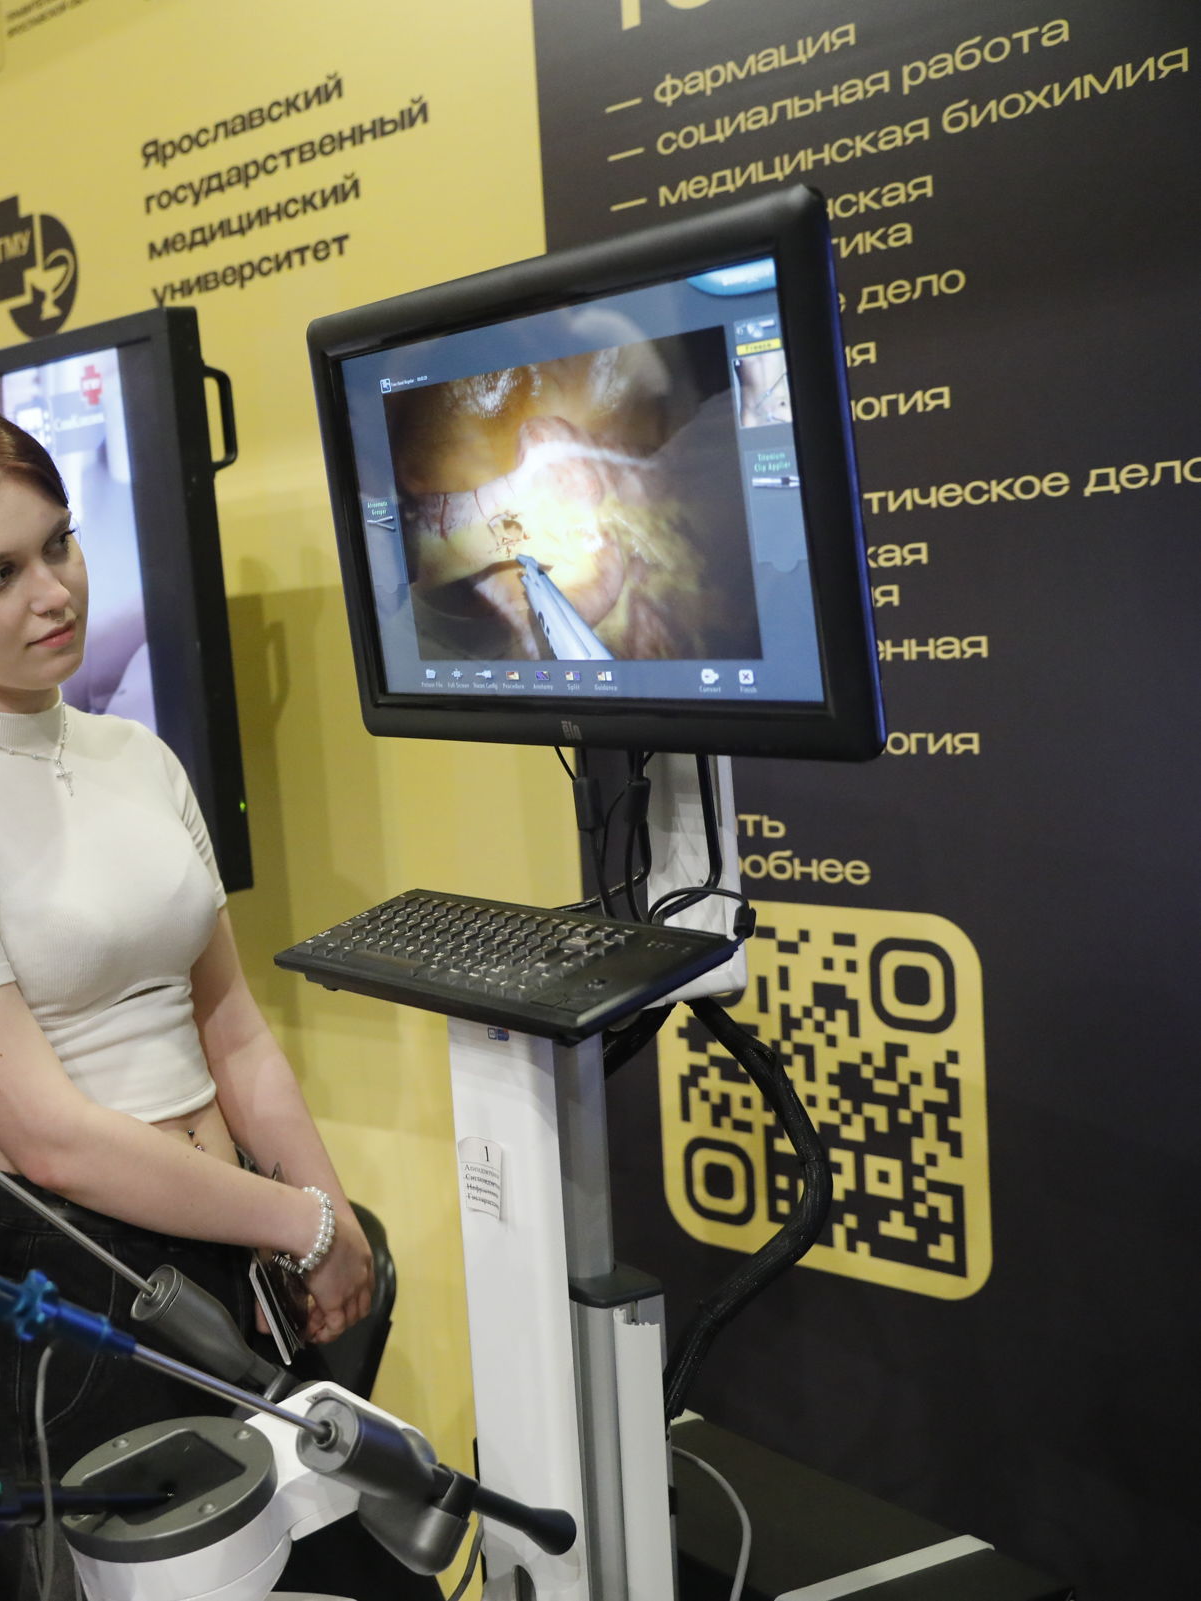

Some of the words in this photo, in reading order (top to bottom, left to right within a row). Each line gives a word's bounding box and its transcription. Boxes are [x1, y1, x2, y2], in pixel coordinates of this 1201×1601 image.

[653, 22, 857, 108] фармация
[656, 70, 891, 157] социальная
[902, 18, 1071, 95] работа
[141, 71, 344, 169] Ярославский
[144, 95, 429, 215] государственный
[658, 117, 930, 208] медицинская
[942, 46, 1189, 136] биохимия
[148, 172, 361, 261] медицинский
[152, 233, 350, 307] университет
[857, 269, 966, 314] дело
[863, 472, 1070, 514] тическое
[882, 731, 981, 756] огия
[739, 850, 872, 886] обнее
